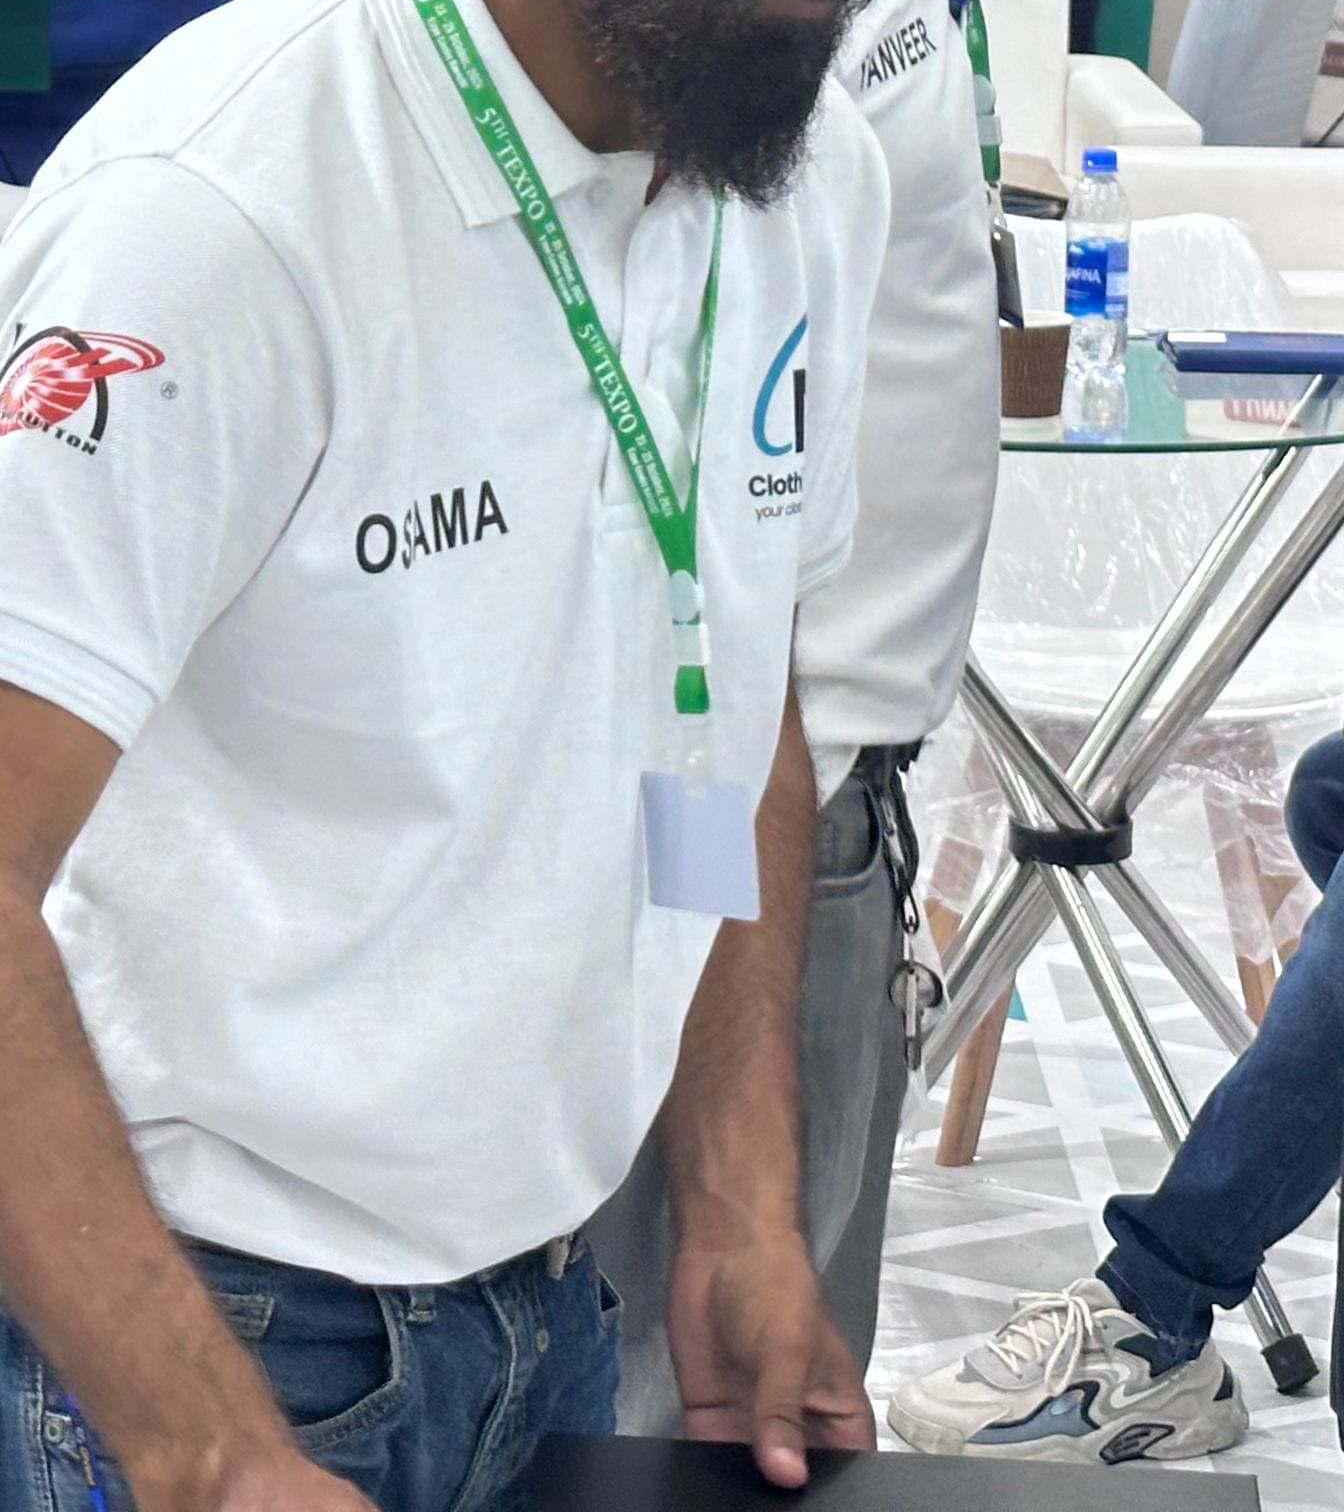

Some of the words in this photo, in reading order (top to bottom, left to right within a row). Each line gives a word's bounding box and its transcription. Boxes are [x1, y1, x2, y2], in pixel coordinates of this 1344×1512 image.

[495, 138, 546, 221] TEXPO
[594, 355, 638, 434] TEXPO
[355, 479, 510, 575] OSAMA
[755, 506, 784, 524] your
